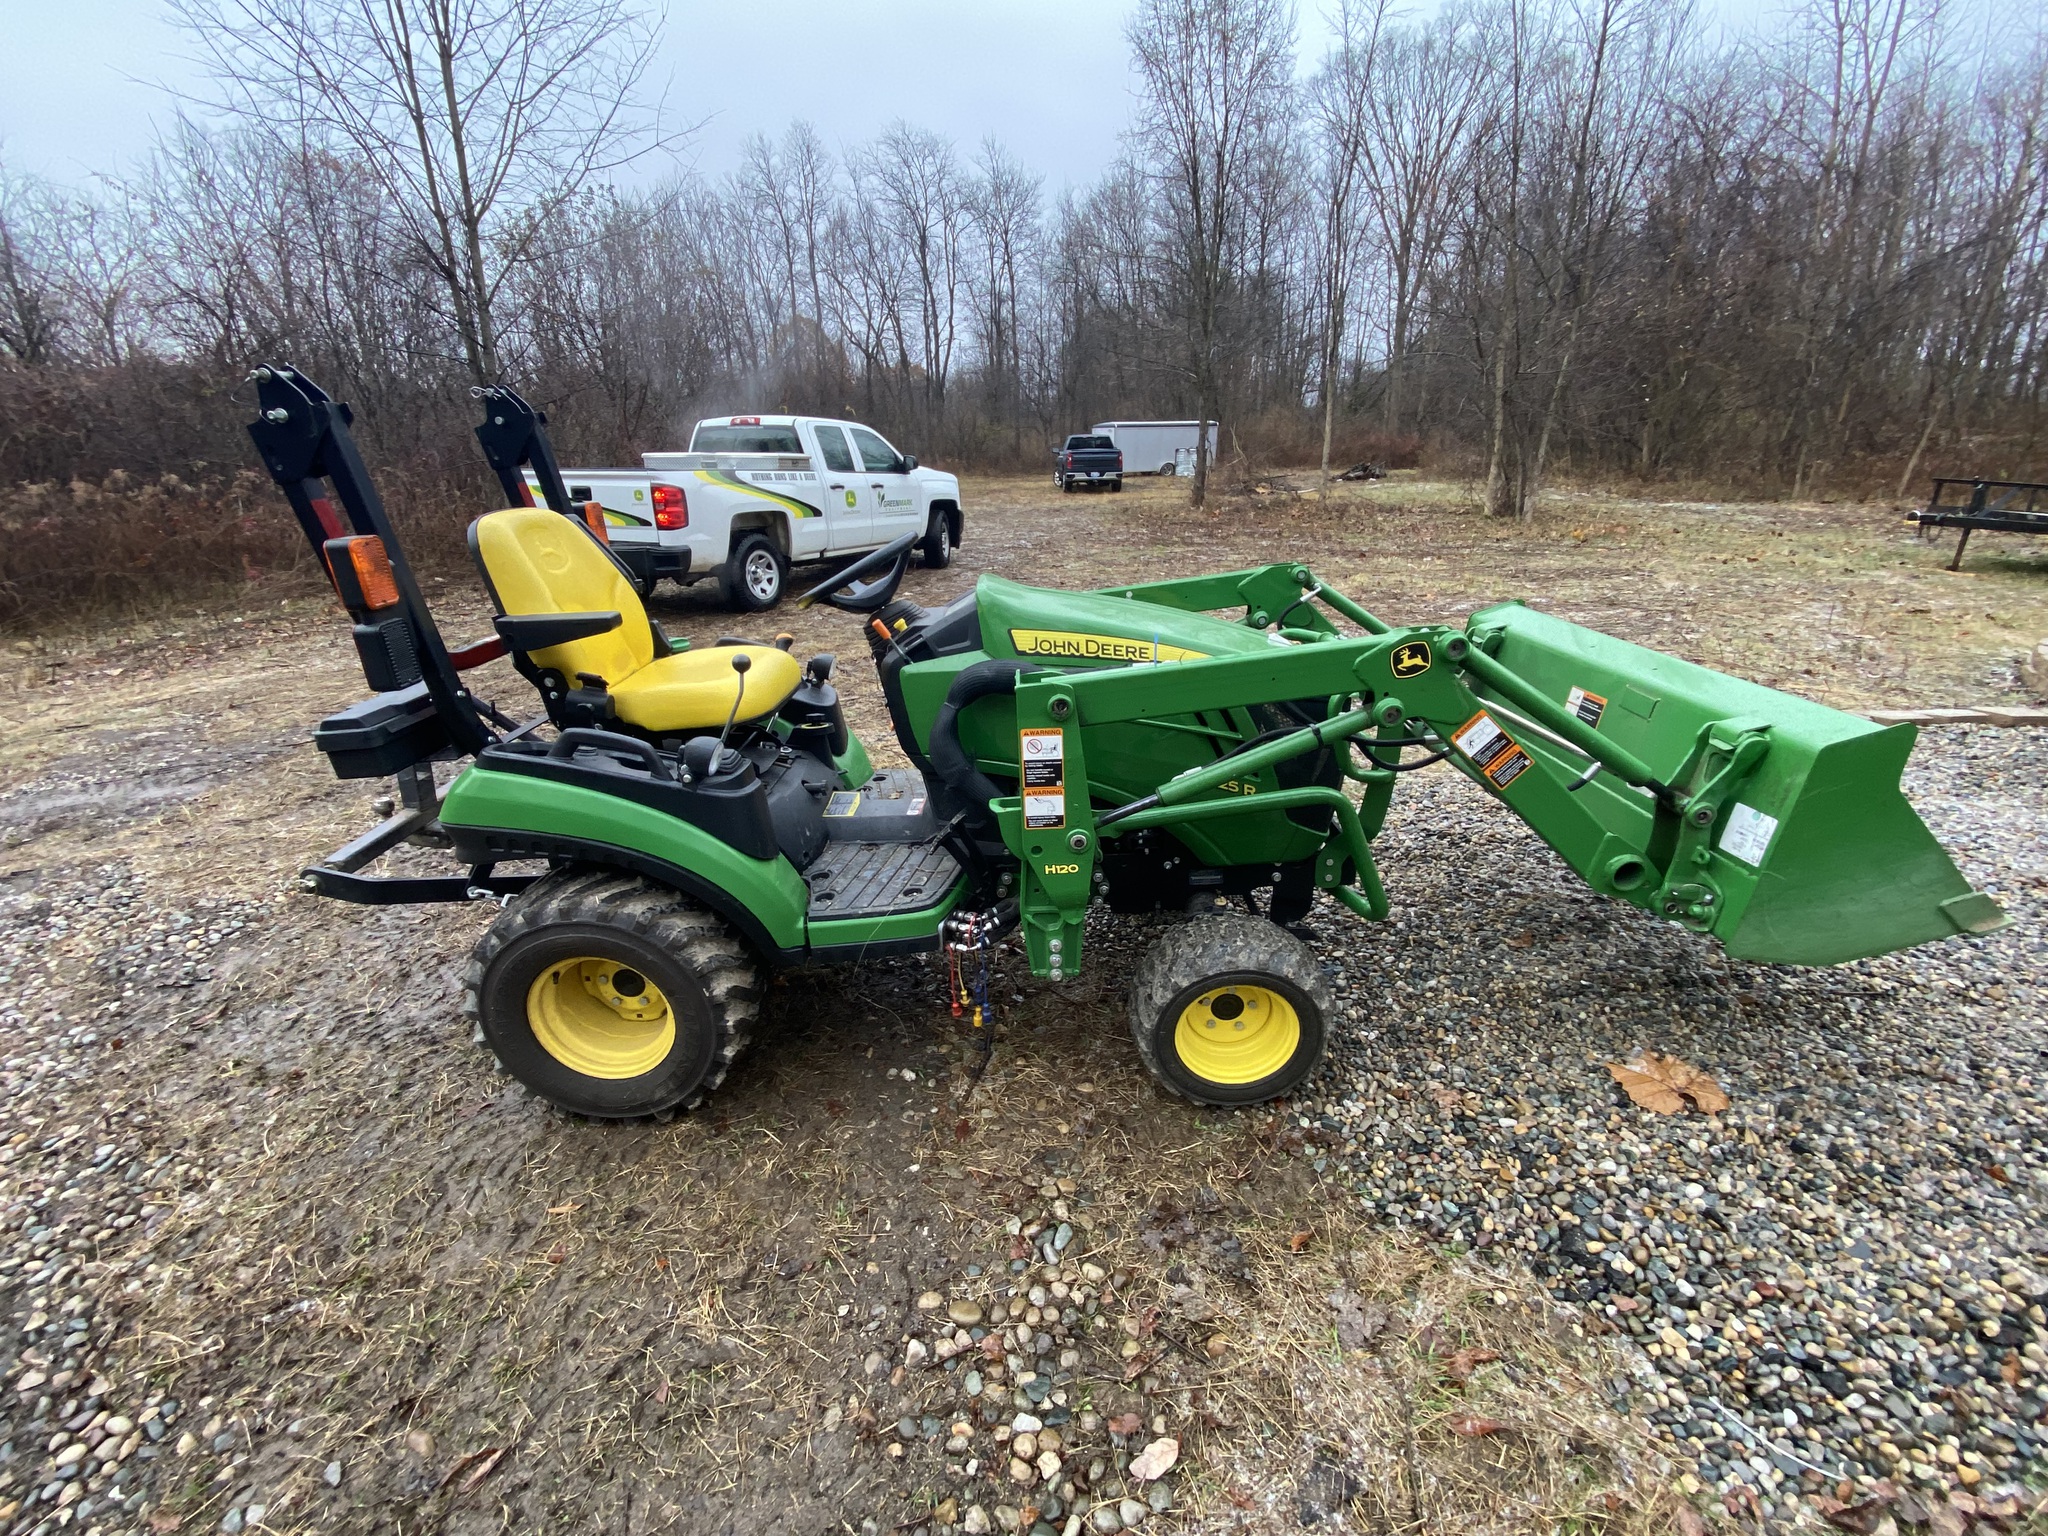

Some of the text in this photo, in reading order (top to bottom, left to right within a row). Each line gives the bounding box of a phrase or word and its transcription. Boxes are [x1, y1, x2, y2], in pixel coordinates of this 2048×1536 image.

[1028, 636, 1150, 660] JOHN DEERE
[1044, 864, 1079, 875] H120
